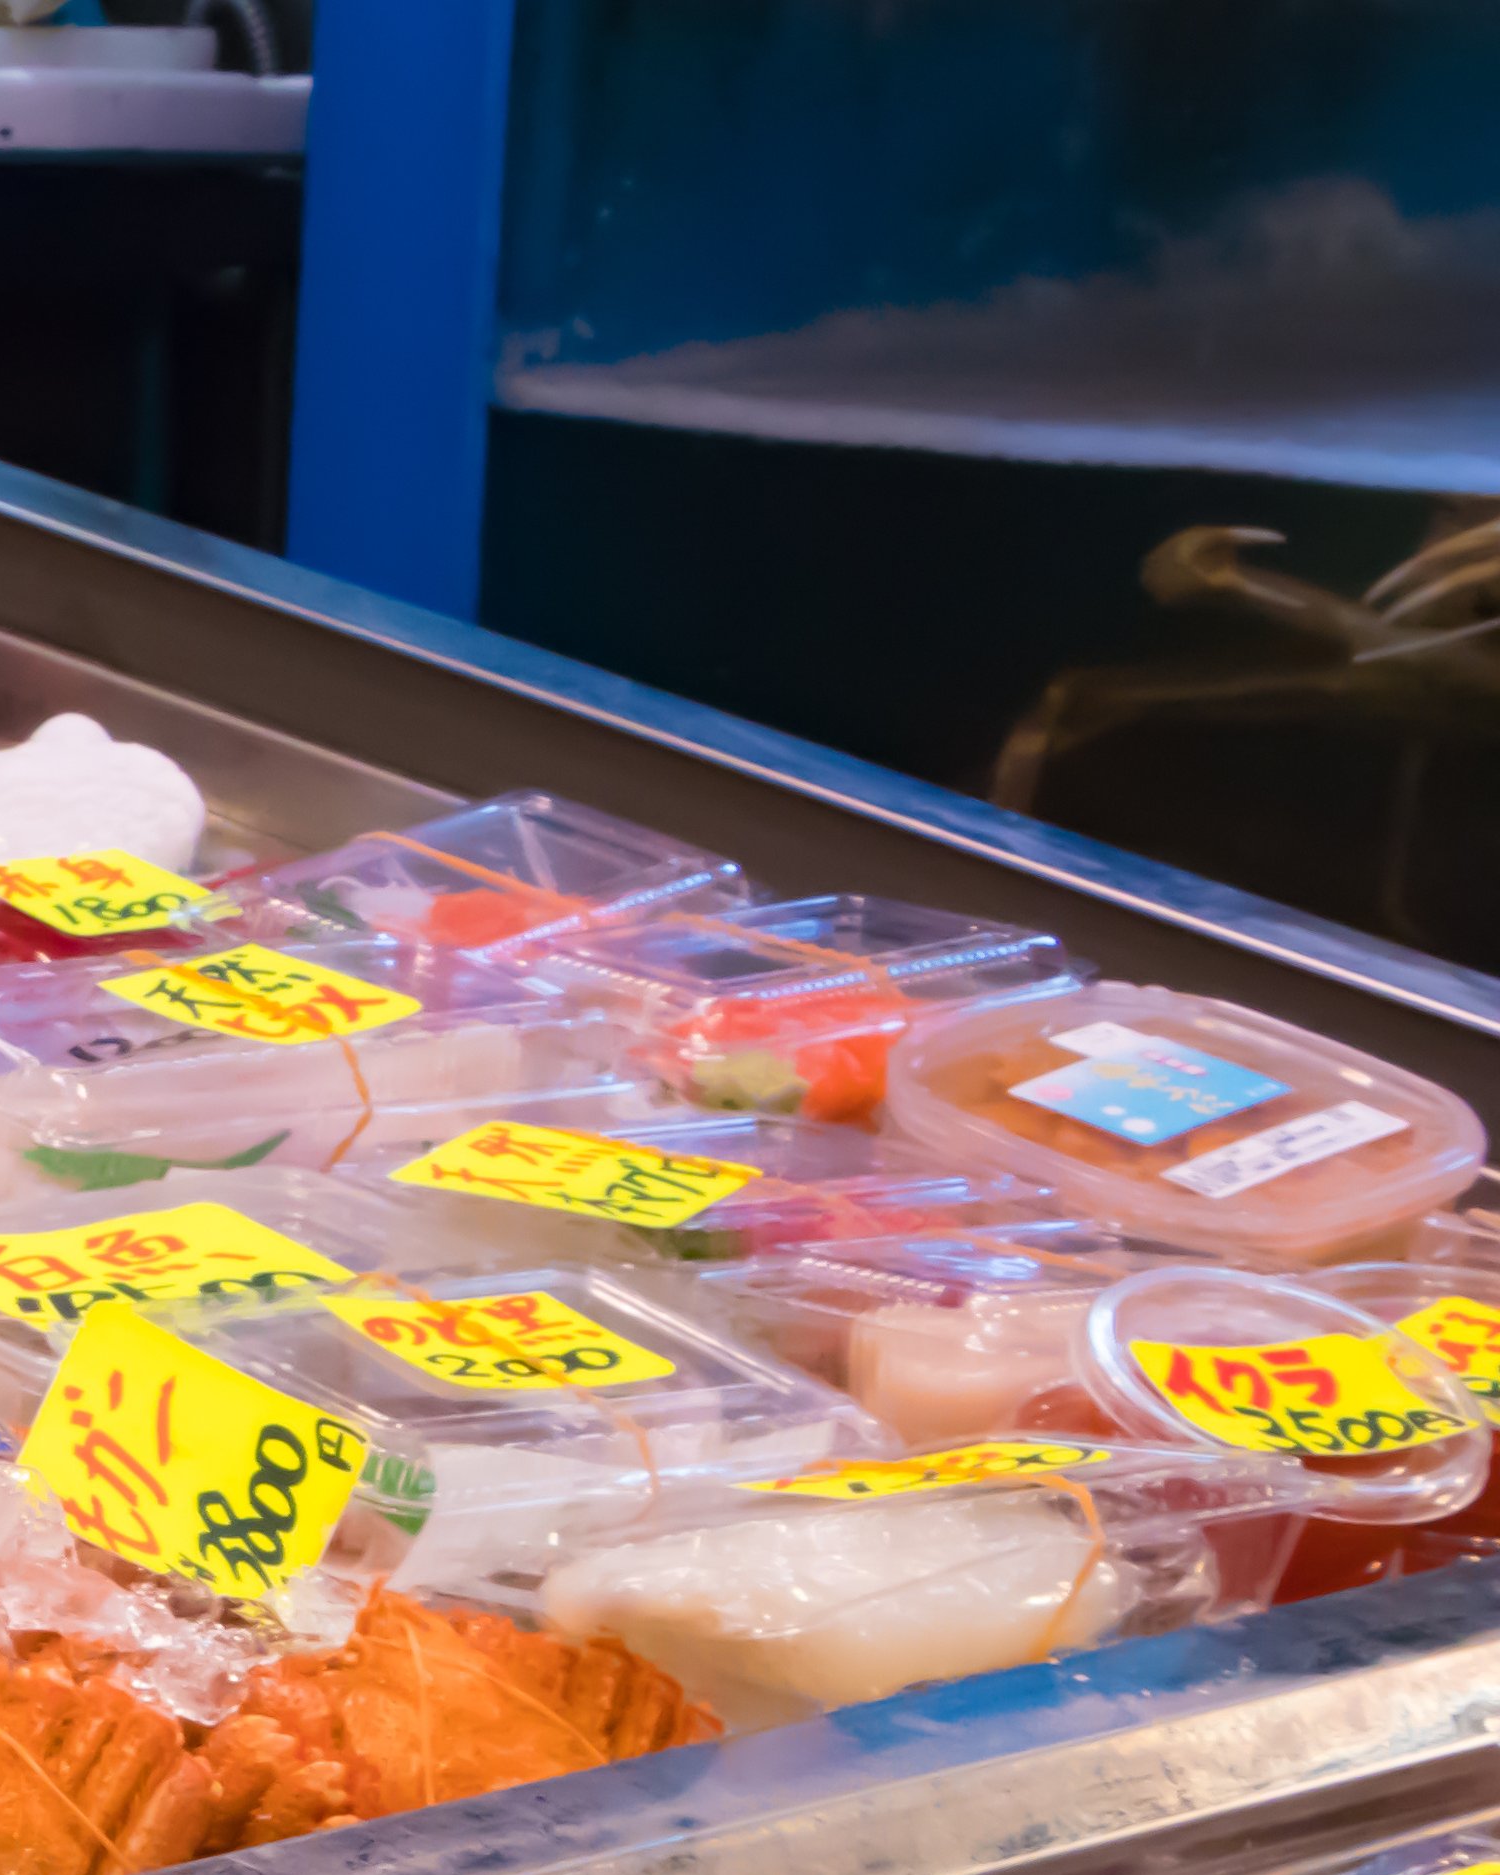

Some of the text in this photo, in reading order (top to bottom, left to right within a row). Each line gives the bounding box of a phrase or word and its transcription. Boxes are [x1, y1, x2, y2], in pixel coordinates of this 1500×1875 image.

[143, 952, 314, 1020] 天然
[430, 1126, 617, 1200] 天然
[1163, 1346, 1340, 1417] イクラ
[61, 1369, 177, 1557] 毛ガニ
